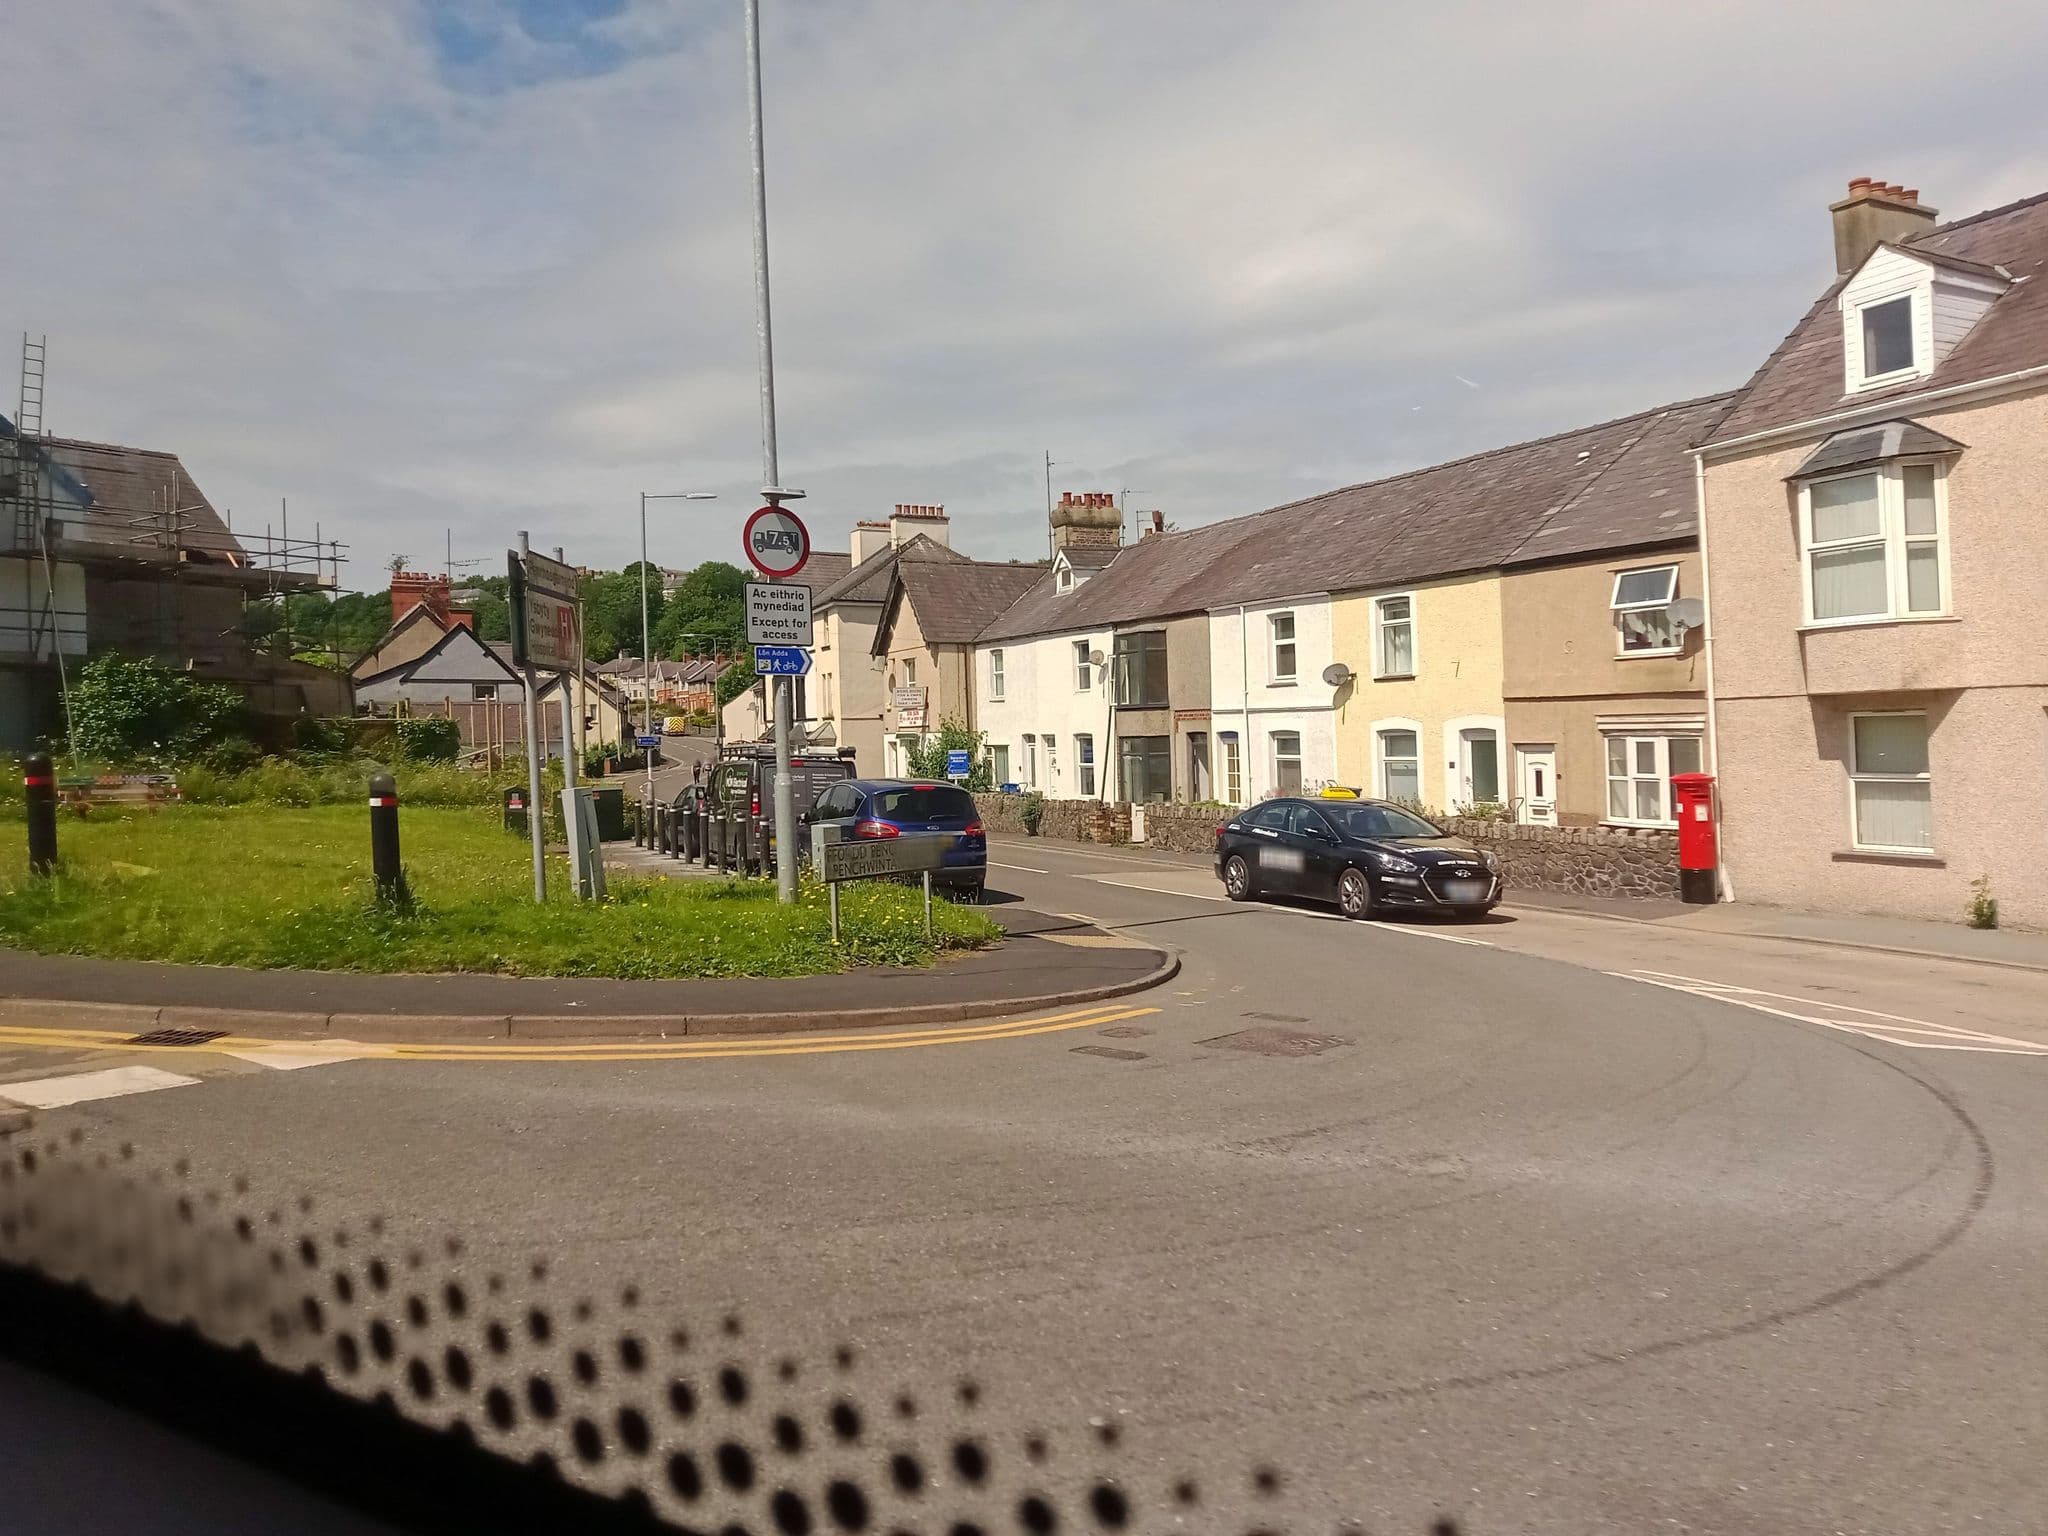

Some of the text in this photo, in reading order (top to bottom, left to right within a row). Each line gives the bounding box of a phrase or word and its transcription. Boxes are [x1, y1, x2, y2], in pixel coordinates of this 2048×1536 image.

[752, 588, 805, 600] Ac eithrio
[753, 601, 804, 612] mynediad
[560, 610, 569, 639] H
[751, 616, 808, 628] Except for
[762, 630, 798, 640] access
